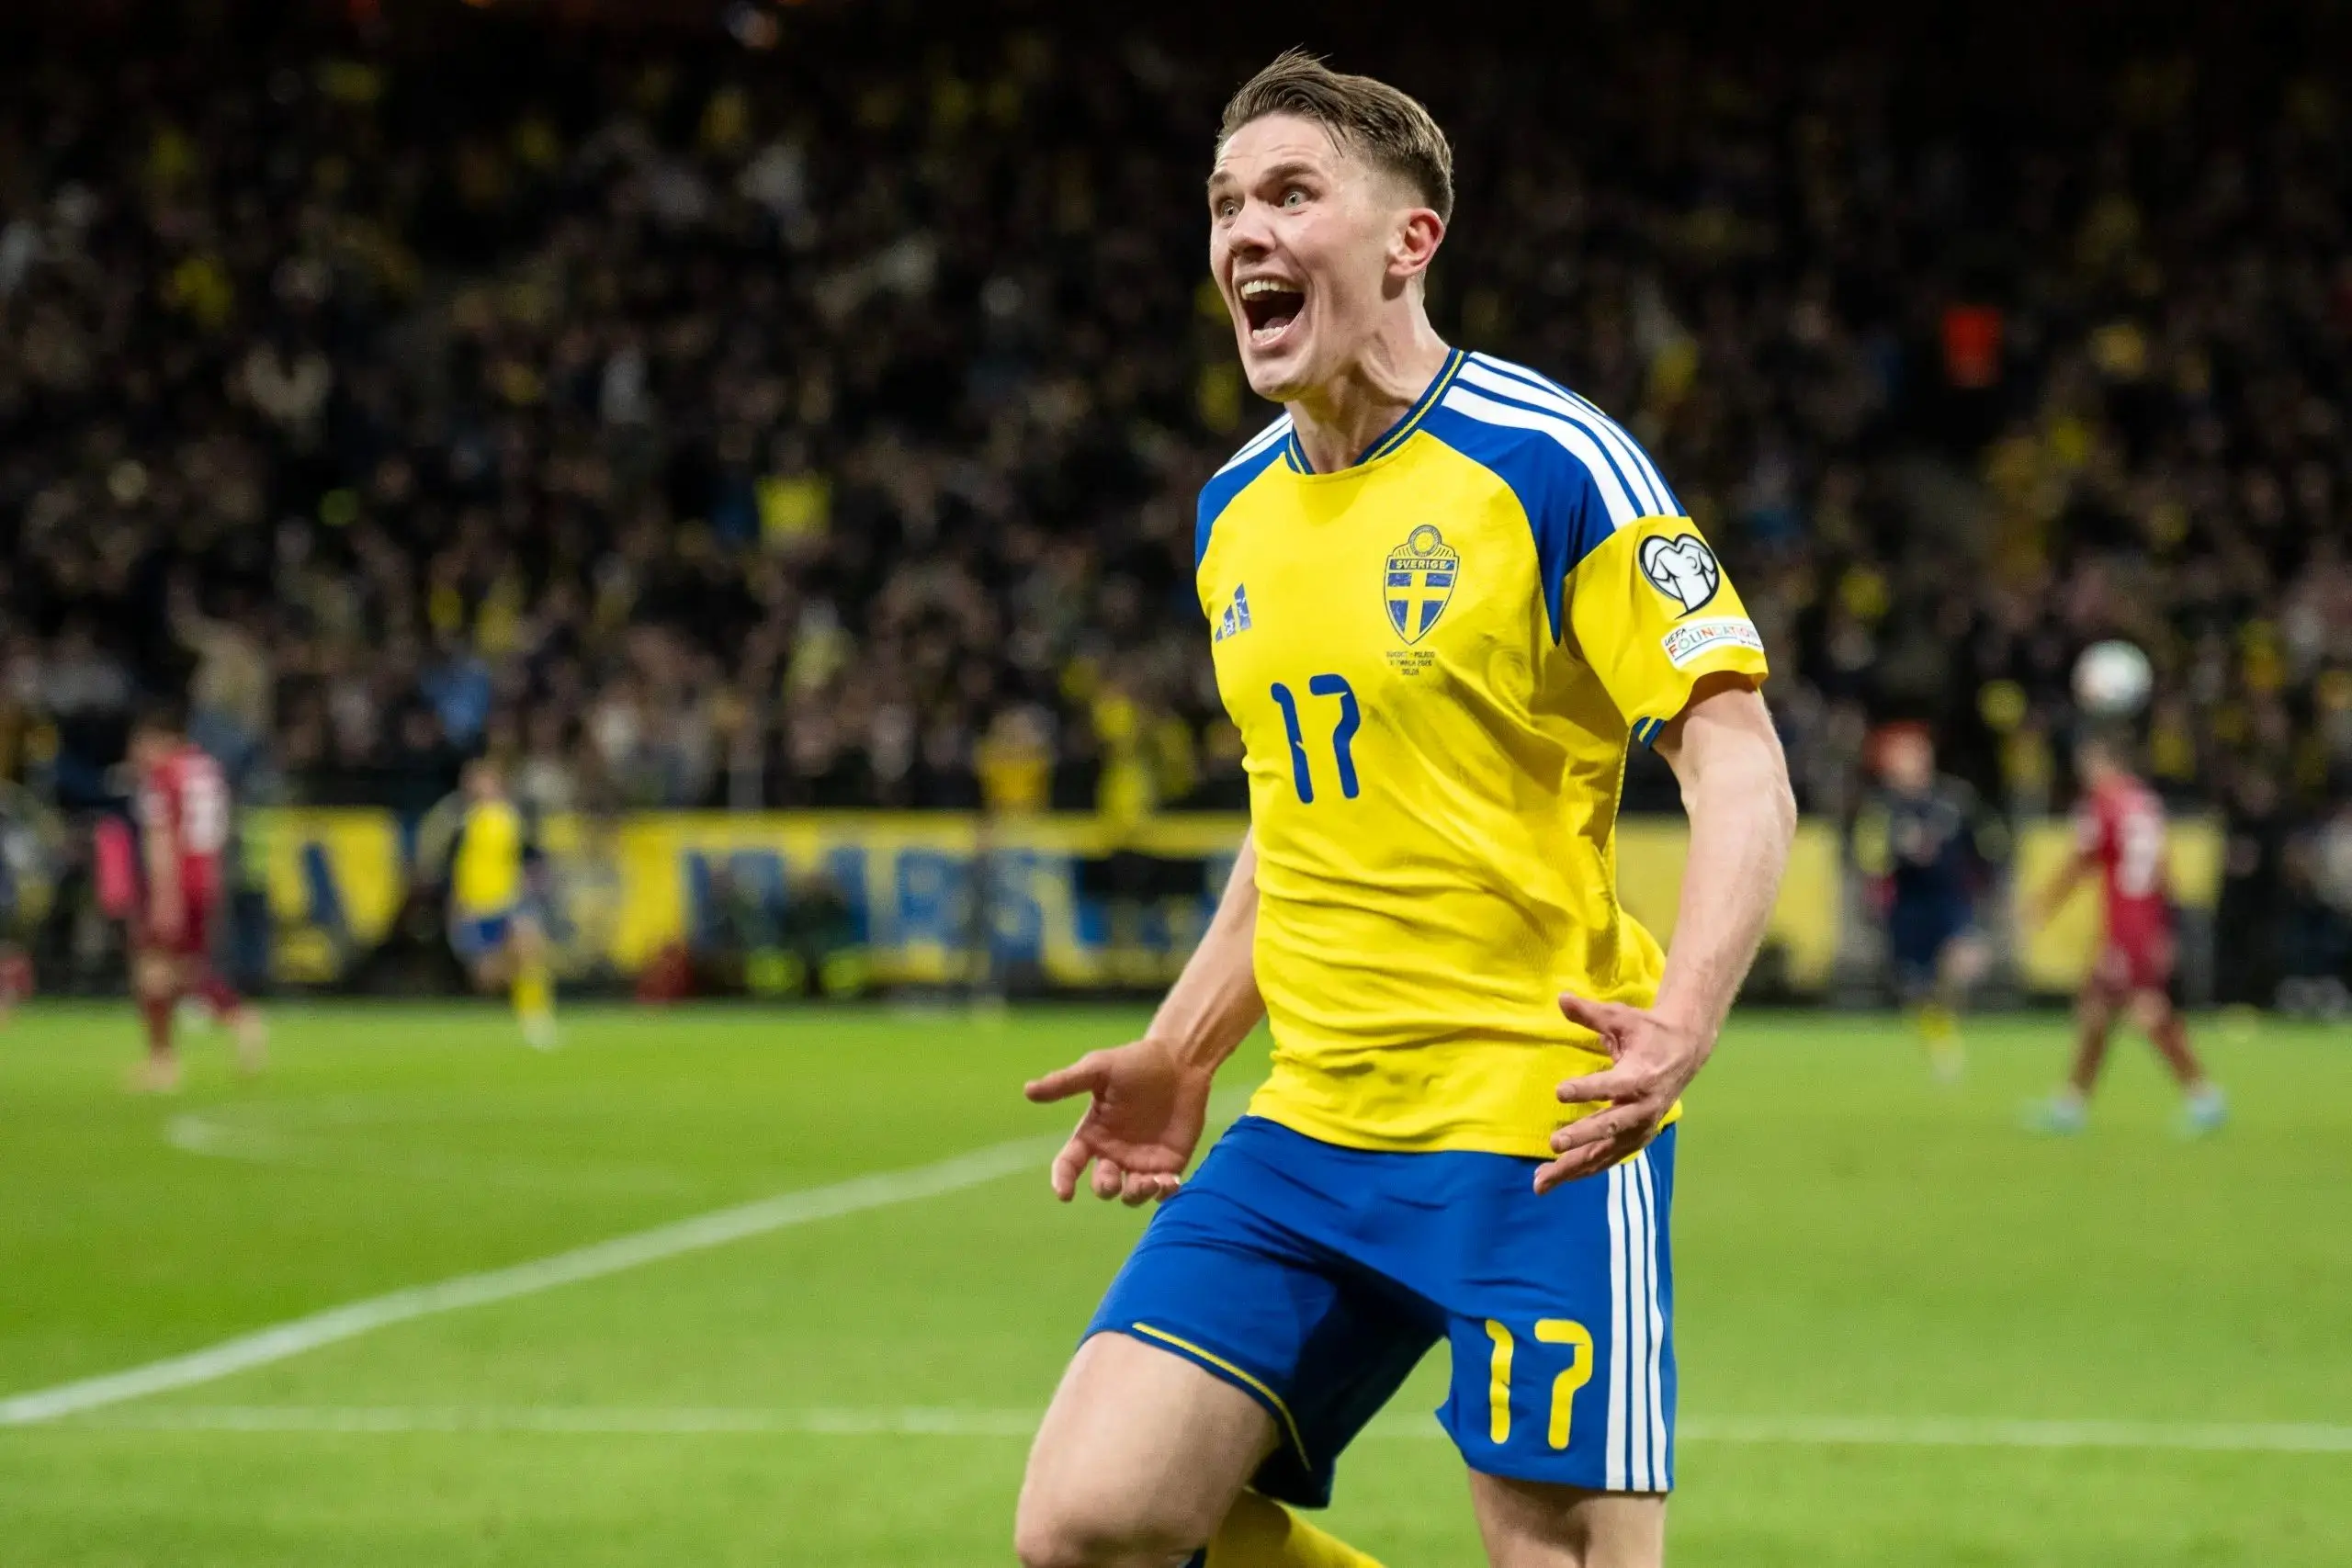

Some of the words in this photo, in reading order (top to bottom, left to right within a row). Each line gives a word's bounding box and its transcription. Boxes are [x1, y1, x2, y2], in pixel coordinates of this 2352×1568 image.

[1396, 559, 1447, 570] SVERIGE
[1665, 627, 1686, 647] UEFA
[1271, 673, 1361, 804] 17
[1485, 1318, 1594, 1450] 17
